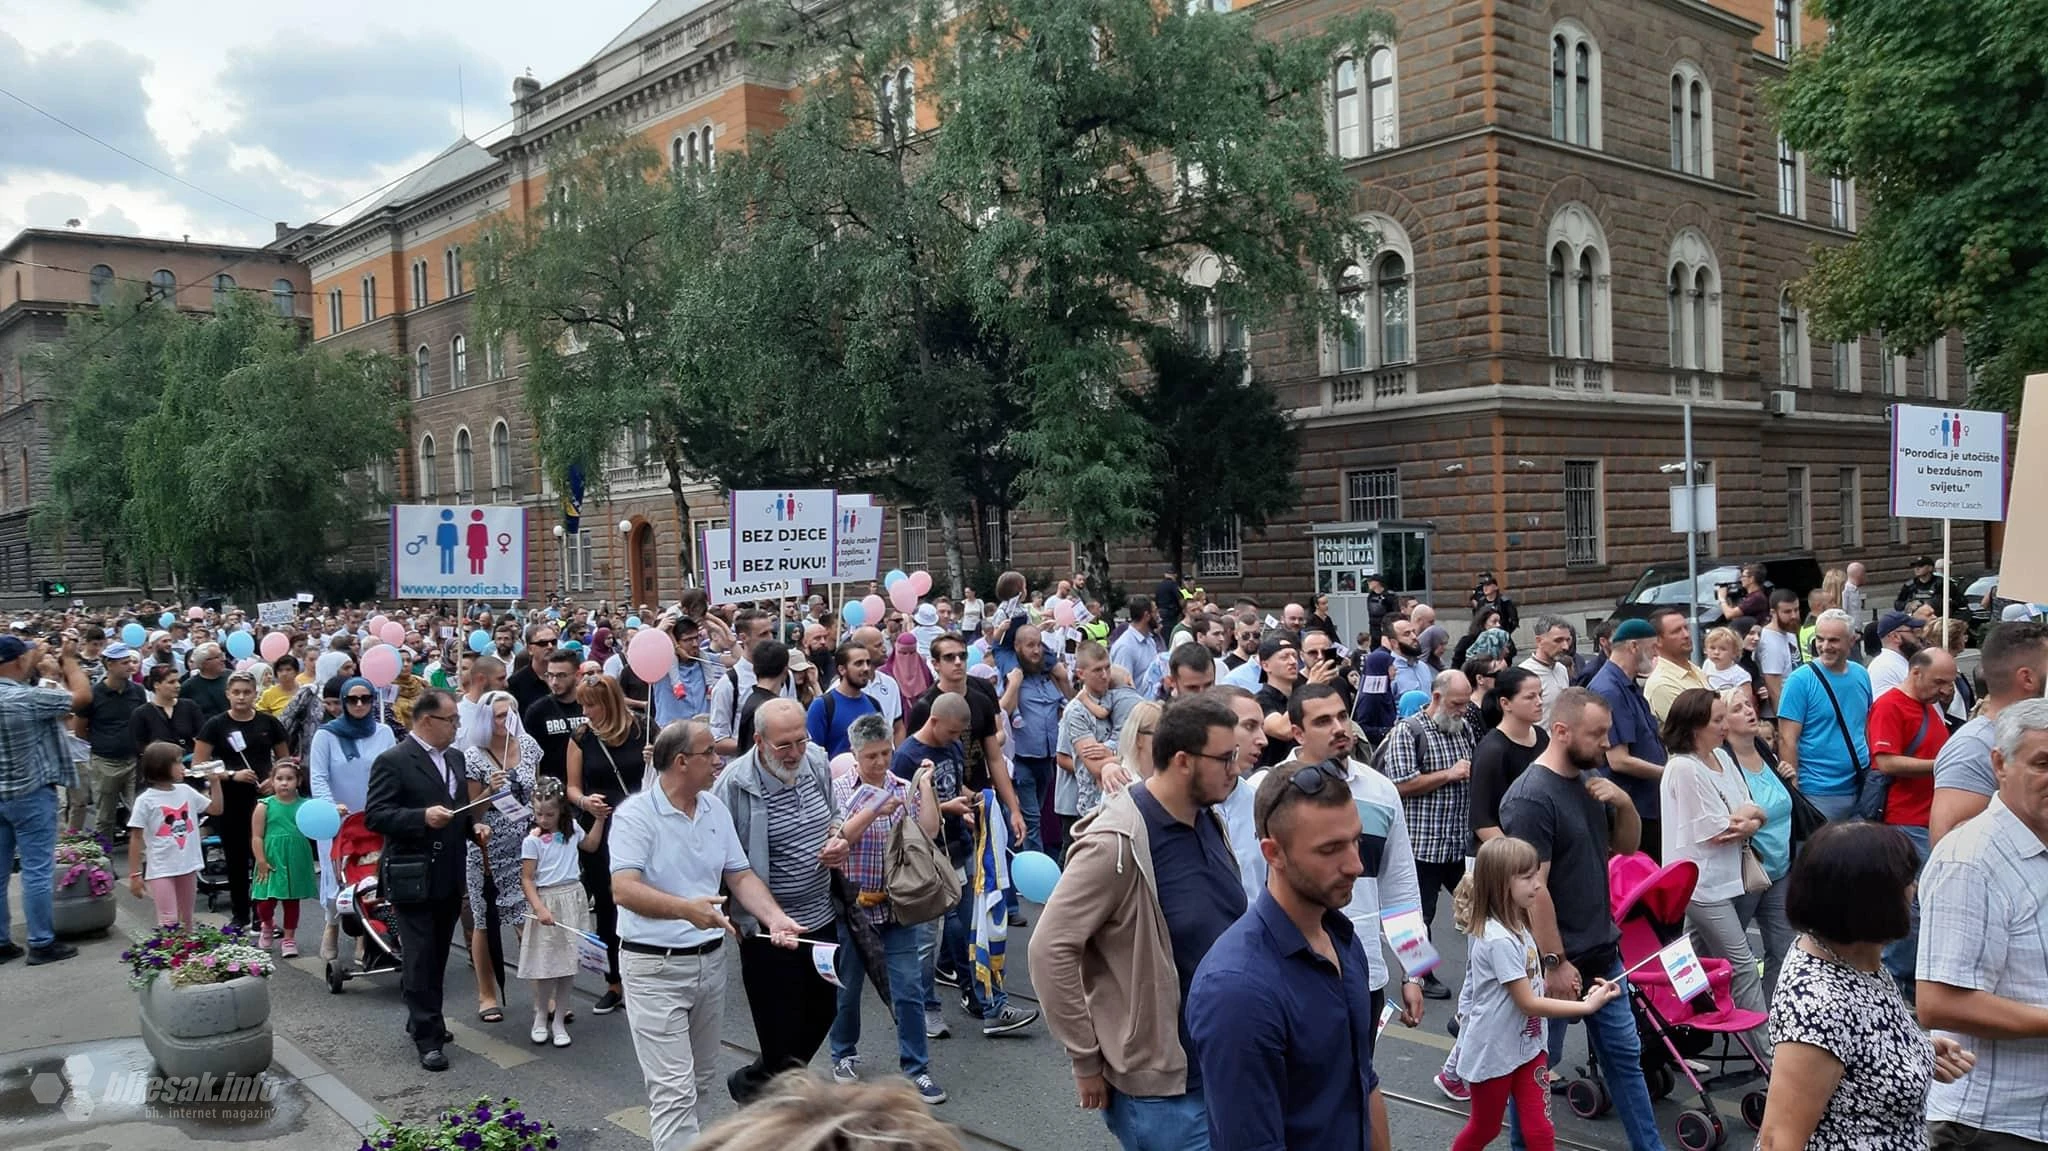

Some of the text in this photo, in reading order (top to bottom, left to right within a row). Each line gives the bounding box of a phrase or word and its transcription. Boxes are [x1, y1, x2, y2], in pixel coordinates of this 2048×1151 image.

[1950, 450, 1959, 462] je
[1962, 451, 2000, 463] utočište
[1917, 465, 1983, 478] u bezdušnom
[1916, 499, 1960, 509] Christopher
[742, 528, 827, 543] BEZ DJECE
[1318, 536, 1373, 550] POLICIJA
[1318, 550, 1373, 564] ПОЛИЦИЈА
[743, 557, 826, 572] BEZ RUKU!
[400, 582, 519, 596] www.porodica.ba
